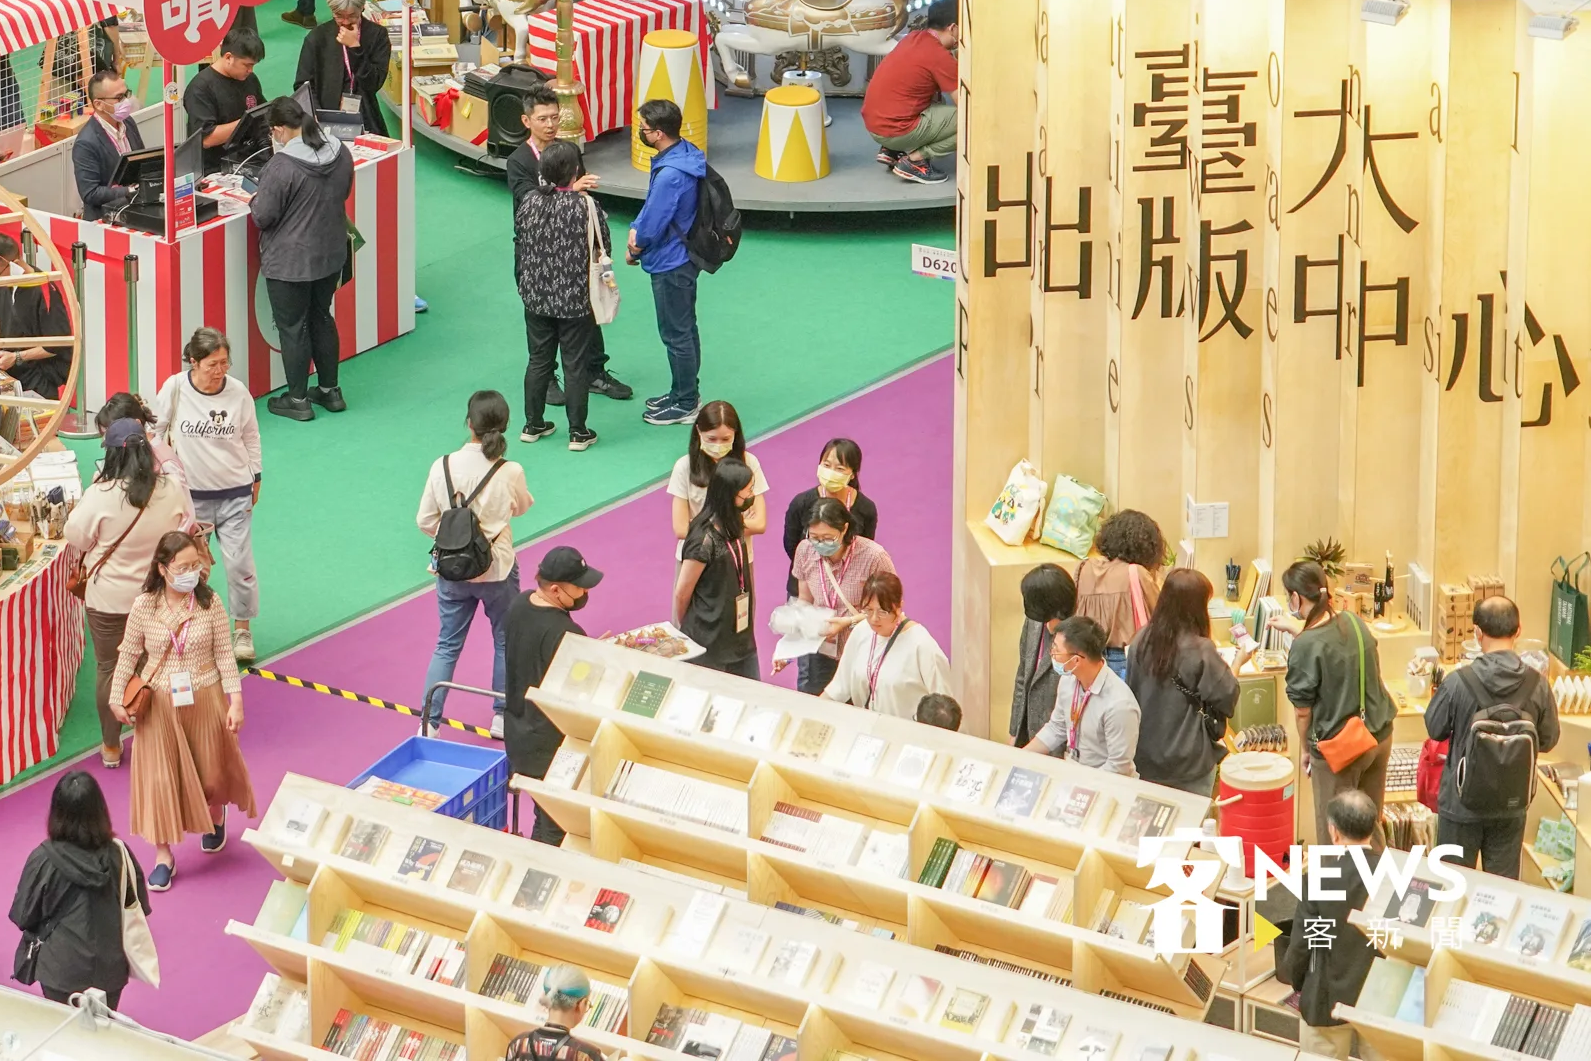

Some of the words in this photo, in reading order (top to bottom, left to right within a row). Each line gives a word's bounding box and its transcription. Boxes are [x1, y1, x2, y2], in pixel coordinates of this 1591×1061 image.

[922, 256, 957, 274] D620
[984, 151, 1582, 429] 出版中心
[180, 419, 235, 438] California
